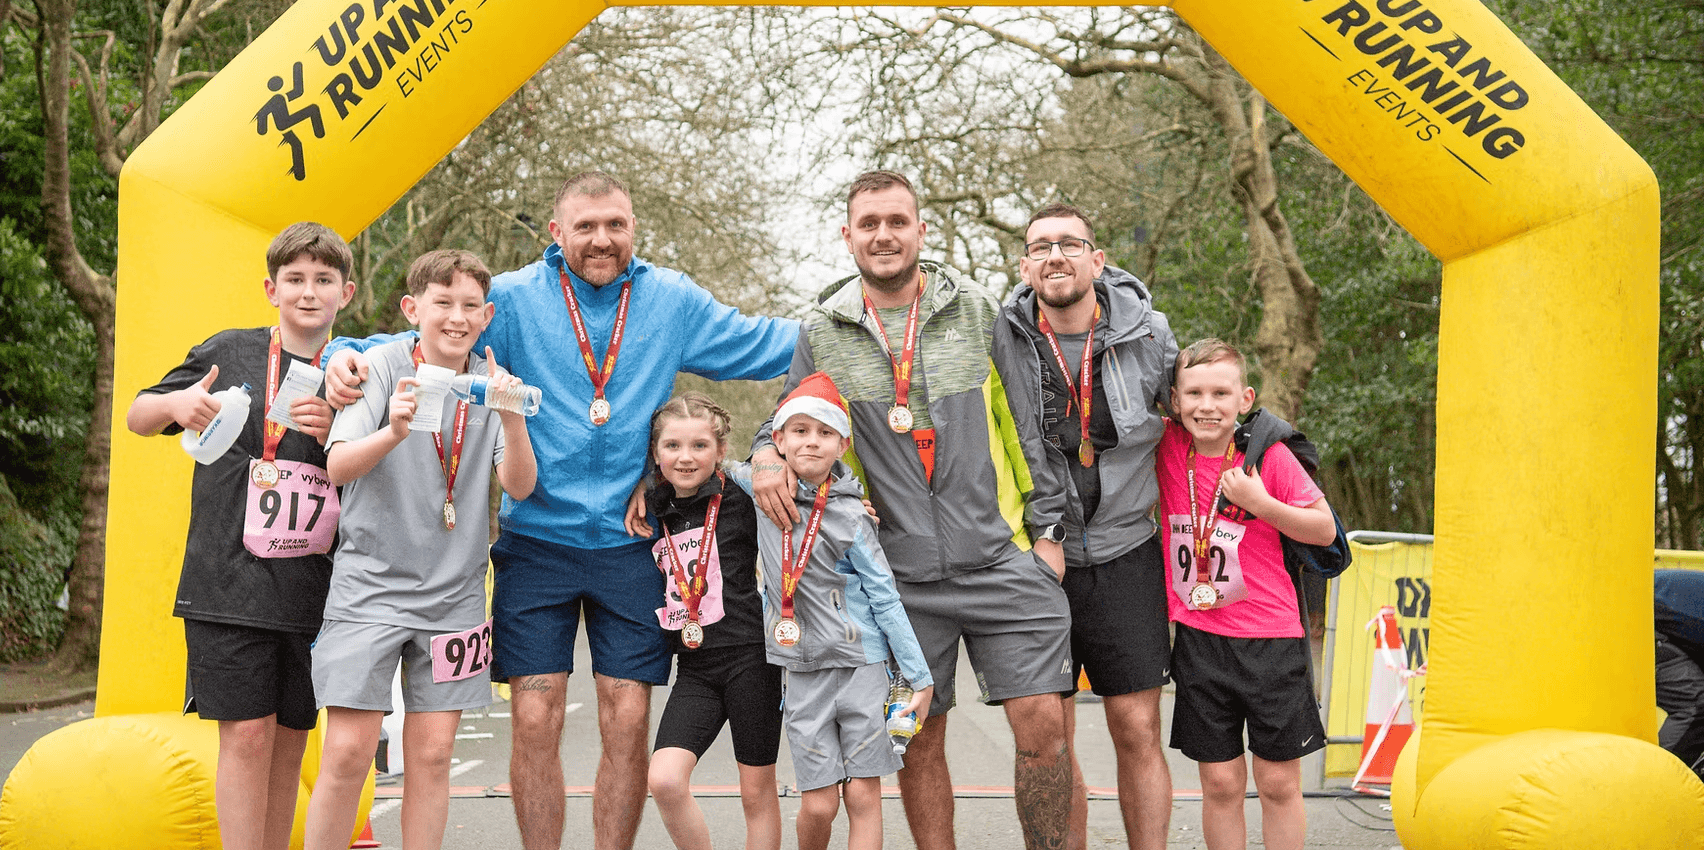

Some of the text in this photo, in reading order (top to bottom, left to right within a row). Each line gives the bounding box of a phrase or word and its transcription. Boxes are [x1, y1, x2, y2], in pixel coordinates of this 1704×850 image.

[308, 2, 366, 66] UP
[321, 0, 451, 120] RUNNI
[396, 9, 473, 98] EVENTS
[1376, 0, 1530, 110] UP AND
[1321, 0, 1525, 159] RUNNING
[1346, 69, 1441, 142] EVENTS
[259, 490, 326, 532] 917
[301, 473, 331, 490] vybey
[678, 537, 702, 553] vybe
[1178, 544, 1230, 582] 92
[445, 625, 490, 677] 923
